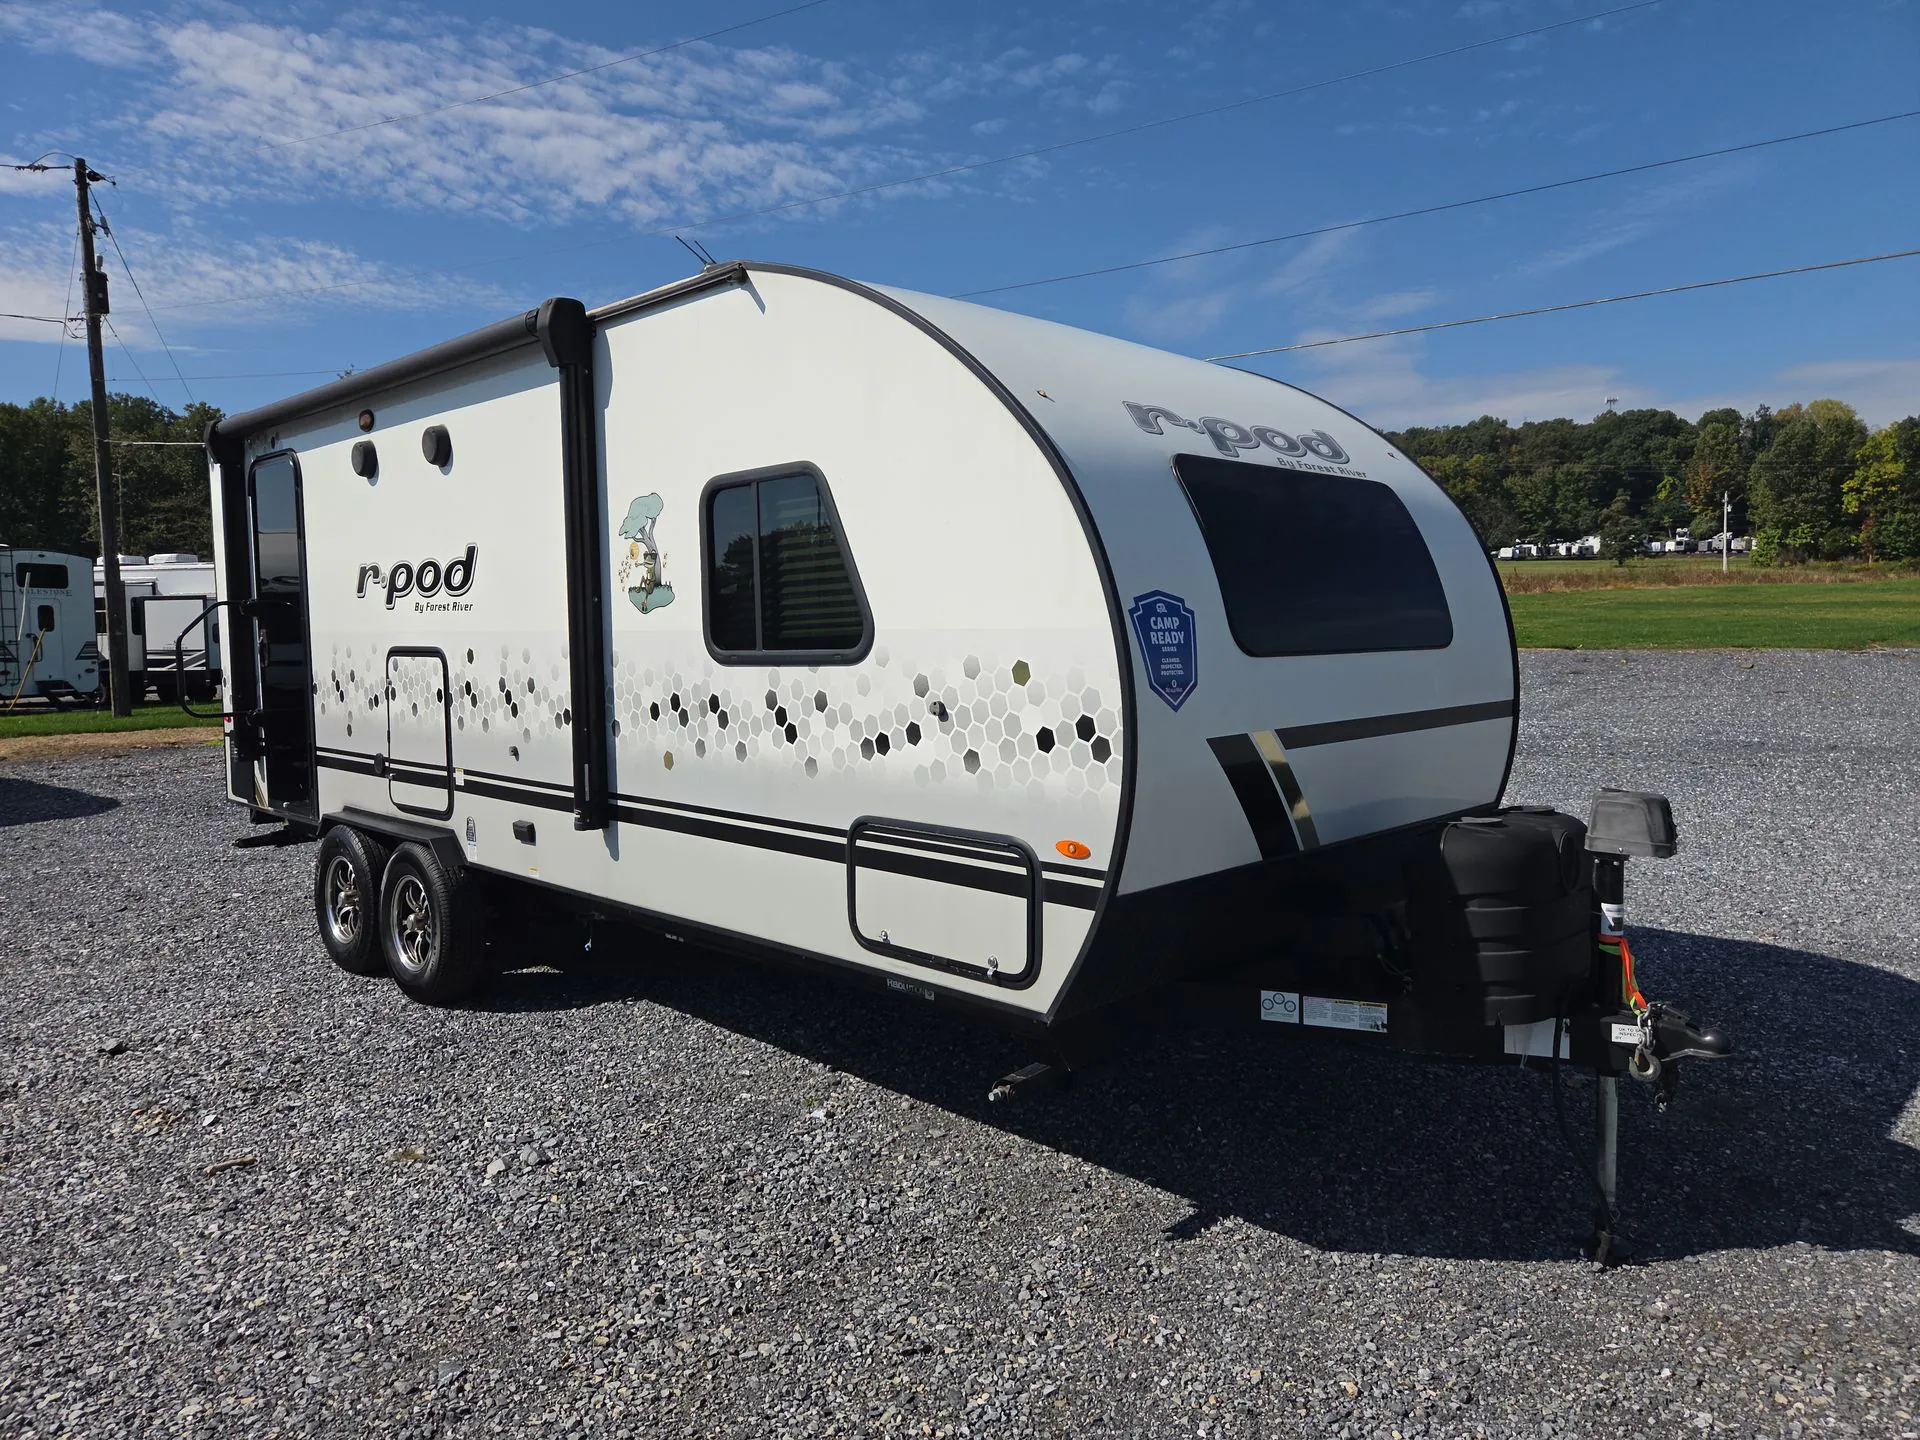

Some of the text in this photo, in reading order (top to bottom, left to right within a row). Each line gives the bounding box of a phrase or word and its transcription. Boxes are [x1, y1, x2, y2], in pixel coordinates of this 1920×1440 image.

[1277, 457, 1367, 478] By Forest River
[415, 601, 473, 613] By Forest River
[1150, 616, 1180, 630] CAMP
[1150, 631, 1185, 645] READY
